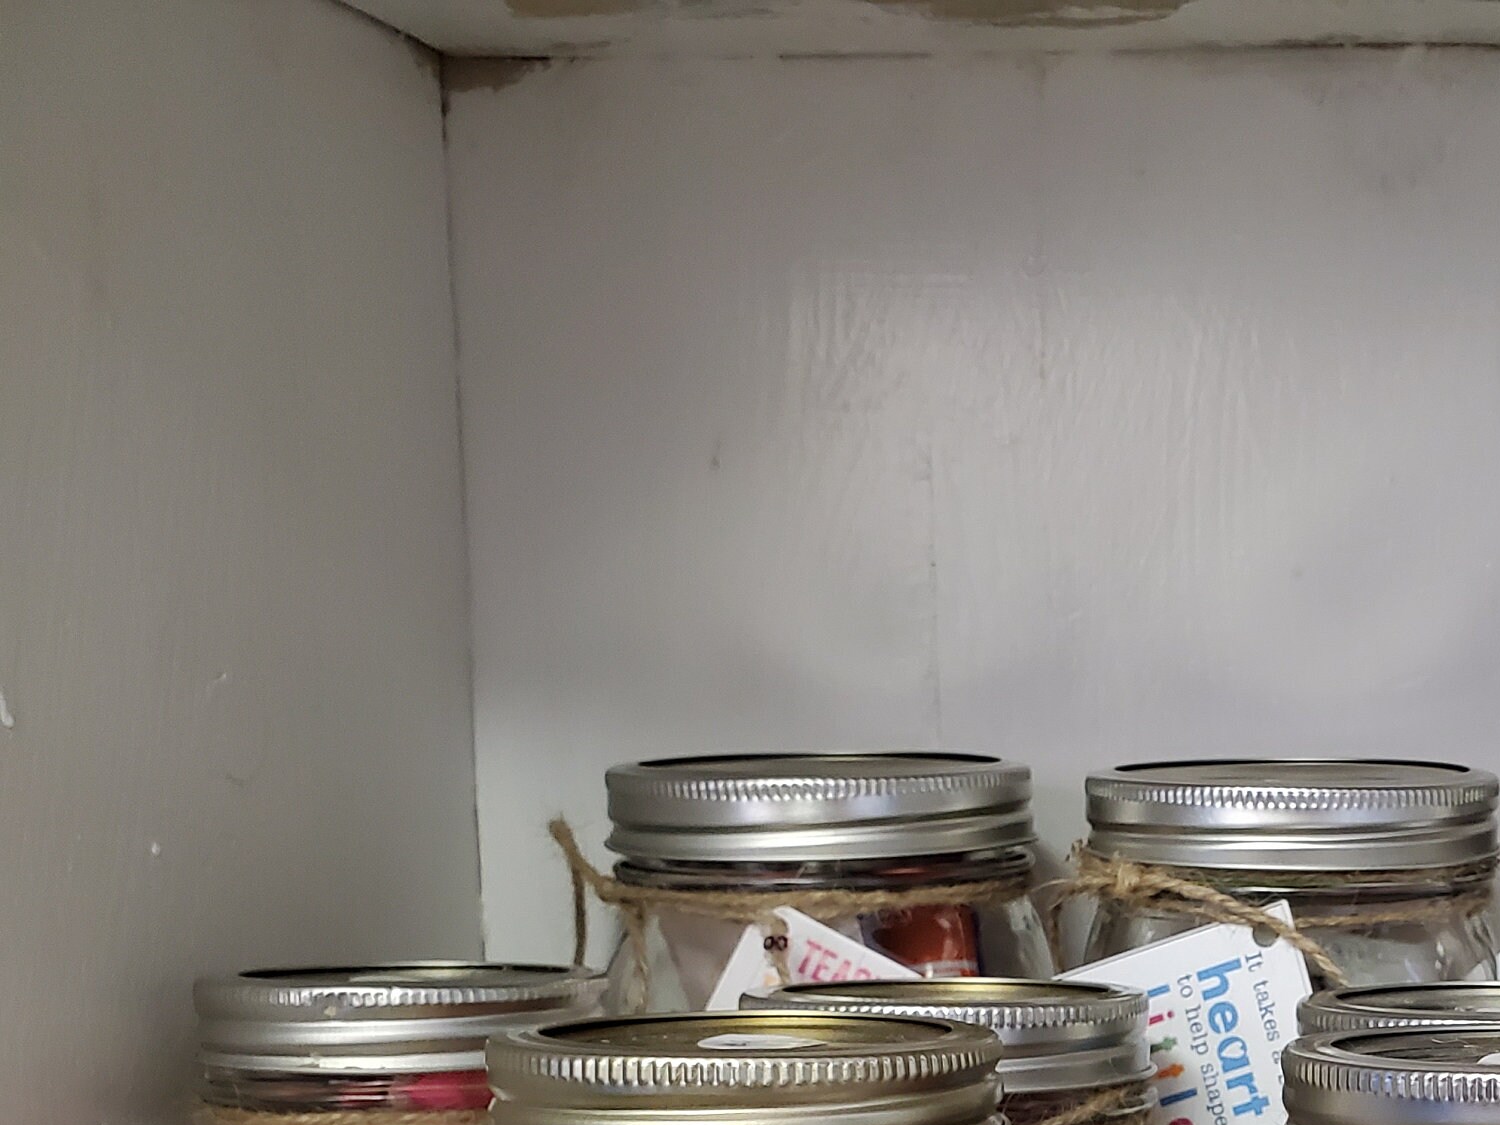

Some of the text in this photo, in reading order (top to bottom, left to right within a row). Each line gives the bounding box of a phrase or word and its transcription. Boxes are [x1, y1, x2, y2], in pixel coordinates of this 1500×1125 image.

[1244, 951, 1263, 973] It
[1177, 973, 1193, 999] to
[1185, 1003, 1210, 1056] help
[1196, 956, 1271, 1117] heart
[1252, 980, 1280, 1042] takes
